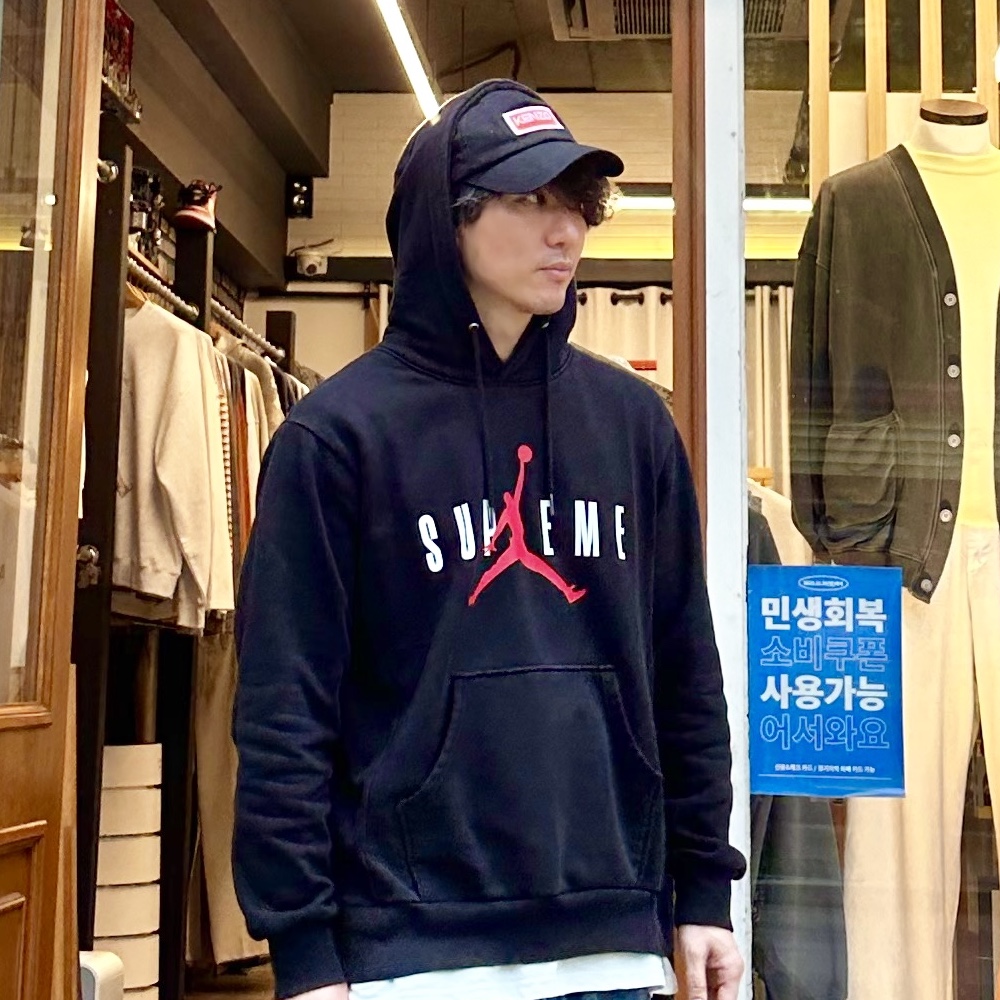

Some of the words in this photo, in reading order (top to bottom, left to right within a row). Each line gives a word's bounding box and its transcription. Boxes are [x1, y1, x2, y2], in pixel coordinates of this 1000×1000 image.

[418, 499, 626, 573] SUPEME
[761, 596, 887, 633] 민생회복
[760, 635, 888, 672] 소비쿠폰
[760, 674, 888, 711] 사용가능
[760, 713, 889, 751] 어서와요
